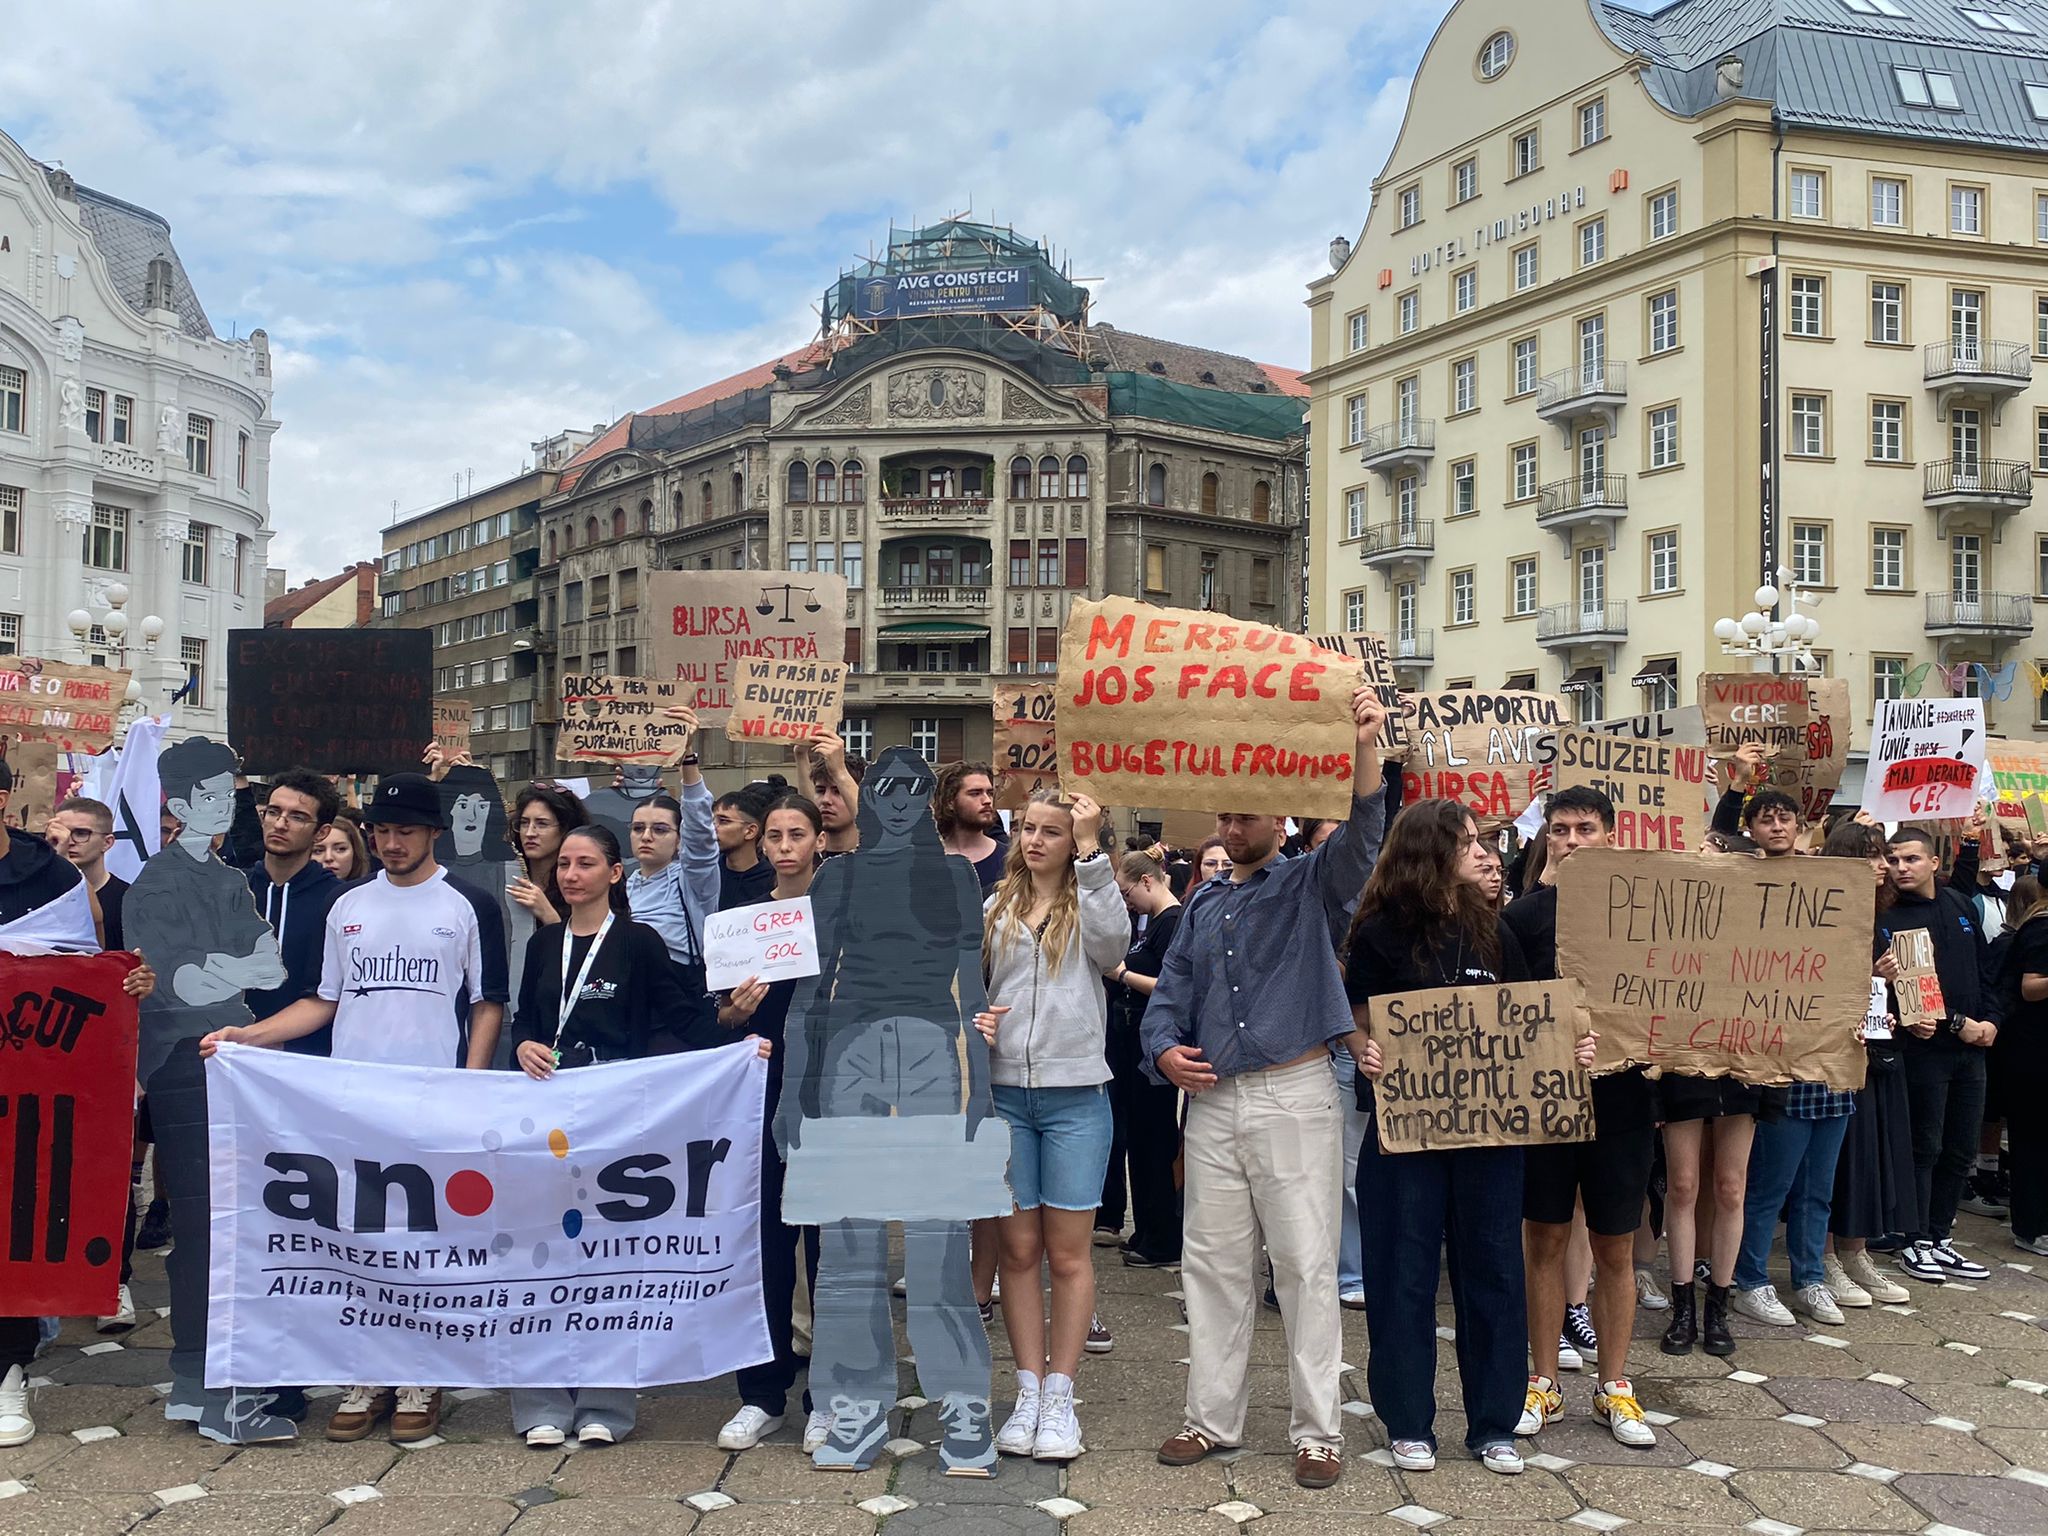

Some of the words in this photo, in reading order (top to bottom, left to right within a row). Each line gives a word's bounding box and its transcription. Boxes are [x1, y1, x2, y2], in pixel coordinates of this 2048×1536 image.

[1410, 238, 1466, 276] HOTEL
[897, 276, 930, 290] AVG
[934, 270, 1019, 287] CONSTECH
[937, 286, 970, 298] PENTRU
[672, 605, 751, 636] BURSA
[724, 632, 818, 660] NOASTRĂ
[1085, 614, 1296, 660] MERSUL
[29, 675, 42, 694] E
[46, 678, 61, 695] O
[564, 677, 613, 698] BURSA
[623, 680, 648, 696] MEA
[658, 684, 675, 696] NU
[677, 662, 706, 682] NU
[716, 662, 728, 682] E
[750, 661, 769, 678] VĂ
[776, 663, 816, 682] PASĂ
[821, 668, 840, 684] DE
[1073, 664, 1156, 707] JOS
[1177, 661, 1327, 701] FACE
[567, 700, 577, 716] E
[606, 700, 654, 715] PENTRU
[1714, 681, 1808, 705] VIITORUL
[742, 715, 765, 737] VĂ
[1730, 704, 1789, 724] CERE
[629, 725, 636, 736] E
[644, 723, 686, 737] PENTRU
[1421, 730, 1469, 767] ÎL
[1562, 734, 1671, 775] SCUZELE
[1674, 747, 1705, 783] NU
[1888, 766, 1915, 787] MAI
[1926, 764, 1975, 782] DEPARTE
[1639, 784, 1665, 807] DE
[753, 910, 804, 933] GREA
[1609, 874, 1724, 942] PENTRU
[1755, 881, 1845, 930] TINE
[351, 945, 439, 983] Southern
[765, 942, 802, 960] GOL
[1646, 948, 1661, 968] E
[1672, 951, 1701, 975] UN
[1731, 947, 1827, 983] NUMĂR
[1612, 973, 1705, 1012] PENTRU
[1742, 989, 1825, 1021] MINE
[1498, 988, 1555, 1042] legi
[1423, 1025, 1524, 1065] pentru
[1647, 1016, 1666, 1056] E
[1689, 1017, 1784, 1056] CHIRIA
[1531, 1069, 1587, 1100] sau
[1540, 1099, 1594, 1140] lor?
[268, 1234, 488, 1270] REPREZENTĂM
[581, 1235, 721, 1259] VIITORUL!
[267, 1276, 366, 1301] Alianța
[379, 1287, 509, 1312] Națională
[522, 1292, 535, 1306] a
[550, 1278, 730, 1305] Organizațiilor
[339, 1307, 498, 1342] Studențești
[509, 1317, 551, 1335] din
[565, 1311, 674, 1332] România
